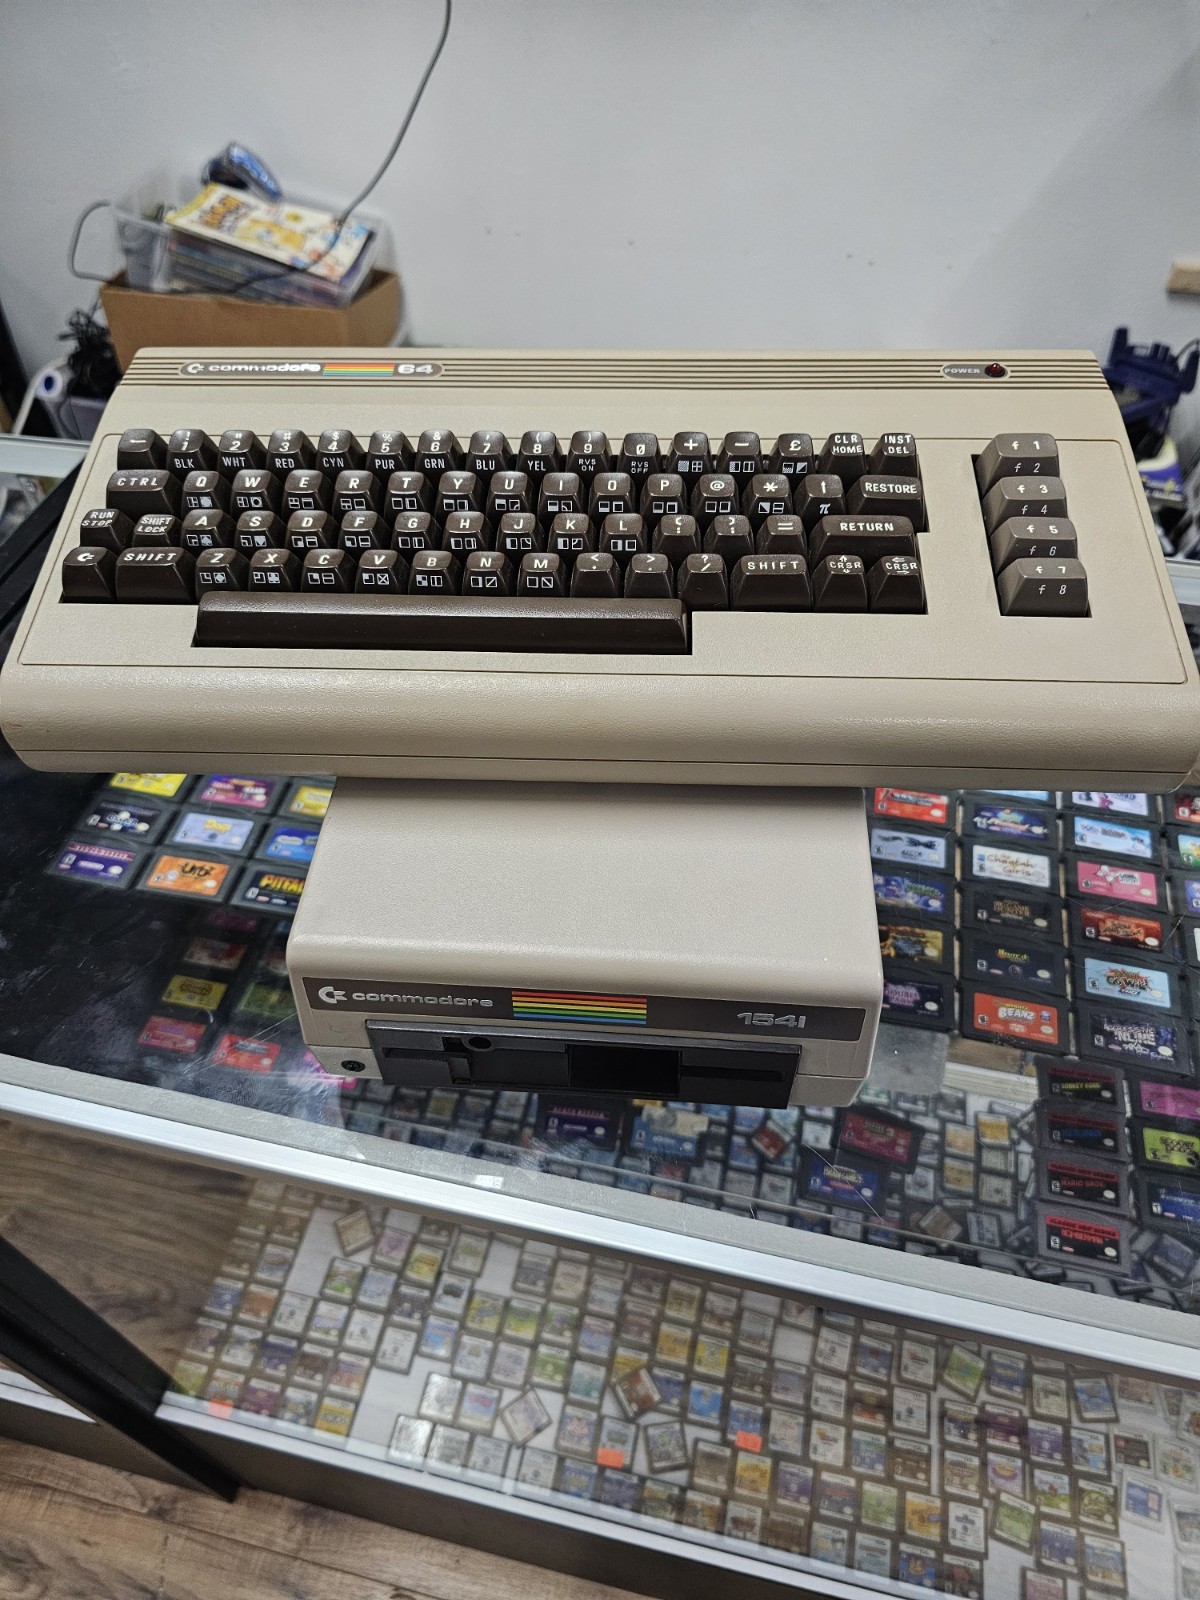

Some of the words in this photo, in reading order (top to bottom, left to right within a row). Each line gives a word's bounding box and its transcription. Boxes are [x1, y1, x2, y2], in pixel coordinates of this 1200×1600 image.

[208, 363, 321, 373] commodore
[397, 364, 434, 374] 64
[834, 434, 858, 444] CLR
[884, 434, 912, 444] INST
[181, 442, 189, 451] 1
[229, 442, 241, 451] 2
[279, 442, 290, 451] 3
[328, 442, 338, 451] 4
[380, 443, 390, 453] 5
[430, 442, 440, 452] 6
[483, 443, 492, 453] 7
[533, 443, 542, 454] 8
[583, 443, 592, 454] 9
[789, 440, 801, 451] £
[832, 446, 862, 454] HOME
[888, 446, 910, 454] DEL
[174, 458, 195, 469] BLK
[222, 456, 246, 467] WHT
[274, 458, 295, 469] RED
[322, 457, 344, 468] CYN
[375, 459, 395, 470] PUR
[424, 458, 445, 469] GRN
[476, 459, 496, 471] BLU
[527, 460, 546, 471] YEL
[116, 477, 158, 487] CTRL
[196, 476, 207, 487] Q
[245, 477, 261, 488] W
[299, 477, 310, 488] E
[348, 478, 360, 489] R
[402, 477, 411, 488] T
[453, 478, 463, 489] Y
[504, 479, 514, 490] U
[660, 480, 670, 491] P
[709, 481, 725, 491] @
[865, 482, 918, 494] RESTORE
[90, 511, 115, 519] RUN
[140, 516, 173, 525] SHIFT
[81, 519, 113, 527] STOP
[194, 516, 208, 526] A
[249, 516, 262, 527] S
[301, 517, 314, 528] D
[354, 517, 365, 527] F
[407, 518, 418, 529] G
[459, 519, 471, 529] H
[513, 519, 524, 530] J
[565, 519, 576, 530] K
[619, 520, 628, 531] L
[840, 522, 894, 531] RETURN
[123, 553, 177, 561] SHIFT
[209, 553, 224, 563] Z
[263, 553, 279, 564] X
[318, 555, 330, 565] C
[374, 555, 386, 565] V
[426, 557, 437, 567] B
[480, 558, 492, 568] N
[533, 559, 549, 569] M
[747, 561, 799, 570] SHIFT
[829, 561, 862, 569] CRSR
[885, 562, 918, 570] CRSR
[352, 992, 494, 1008] commodore
[998, 1007, 1035, 1020] BEANZ
[737, 1012, 806, 1028] 1541
